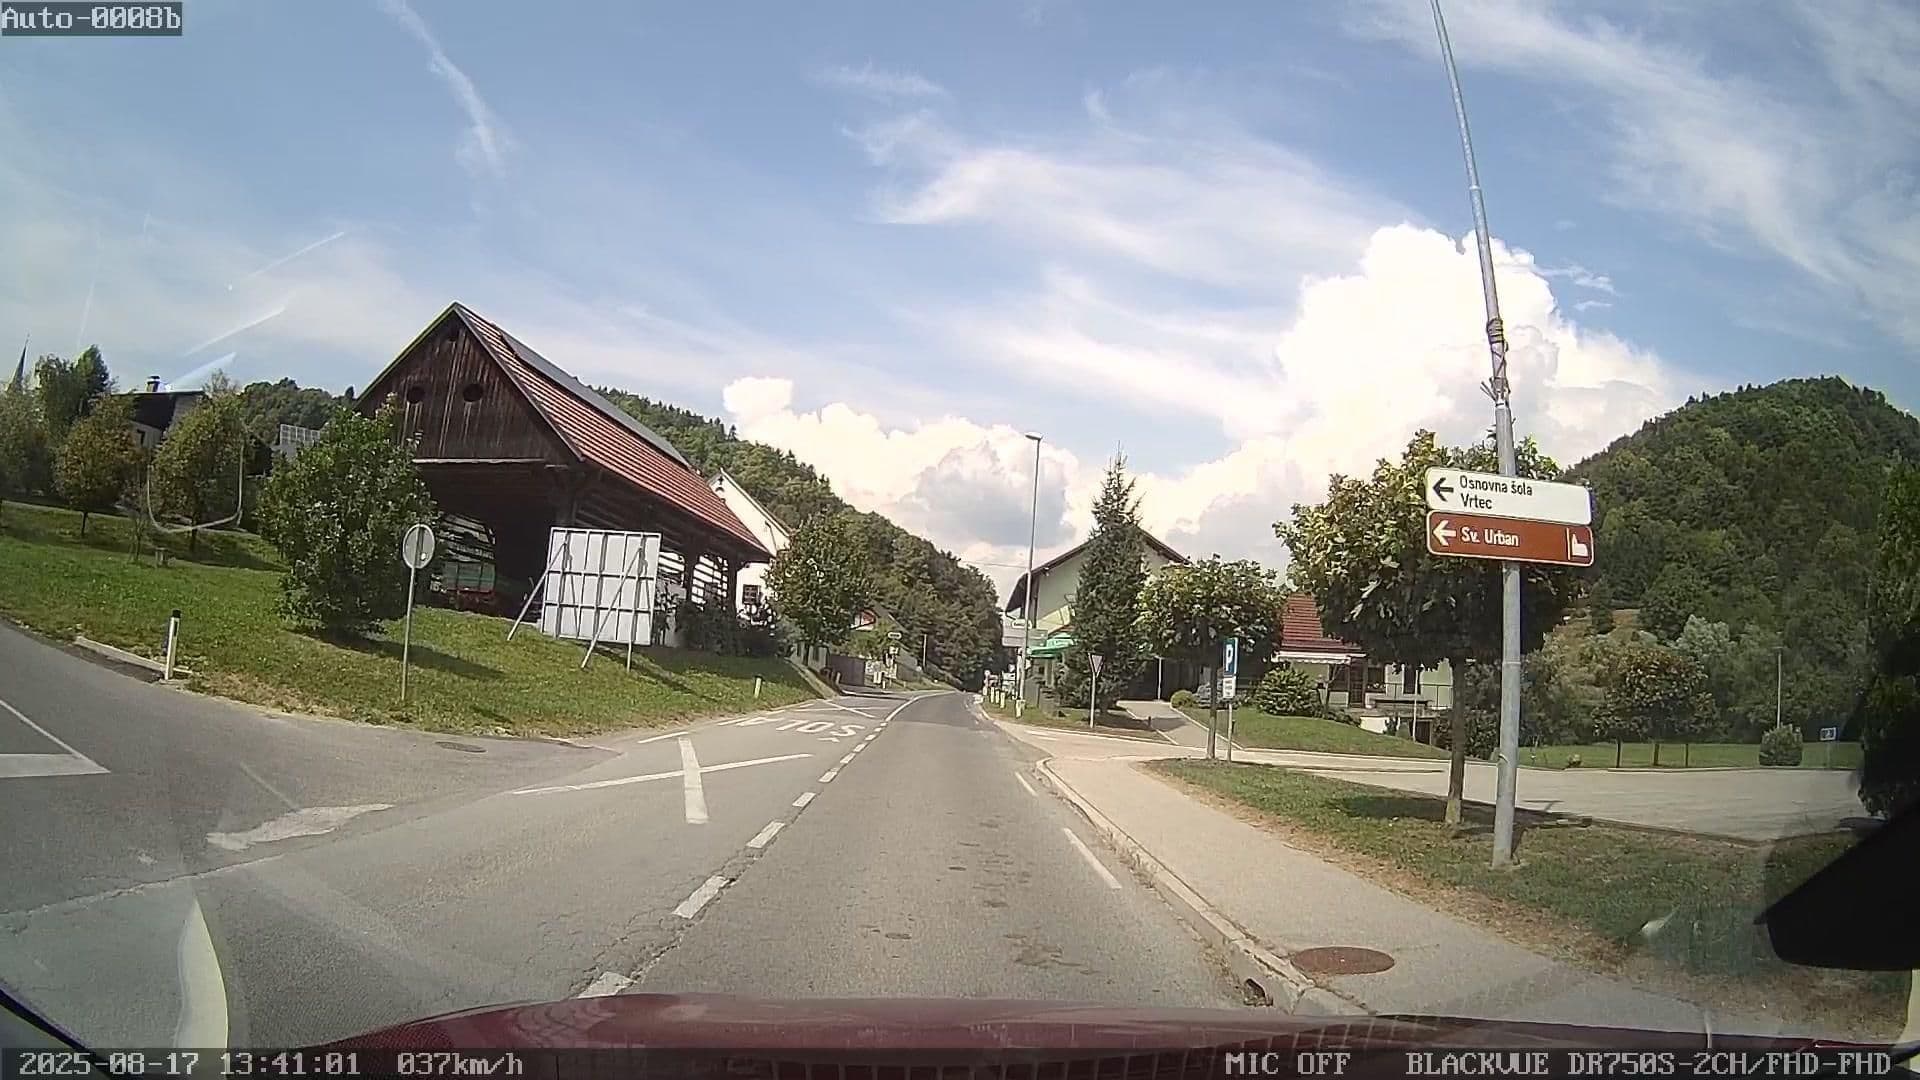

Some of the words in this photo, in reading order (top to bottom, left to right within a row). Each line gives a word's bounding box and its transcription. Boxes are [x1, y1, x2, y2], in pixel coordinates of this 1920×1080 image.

[1459, 475, 1508, 494] Osnovna
[1511, 480, 1533, 496] šola
[1460, 493, 1493, 510] Vrtec
[1461, 527, 1480, 543] Sv.
[1484, 528, 1519, 547] Urban
[1225, 643, 1234, 672] P
